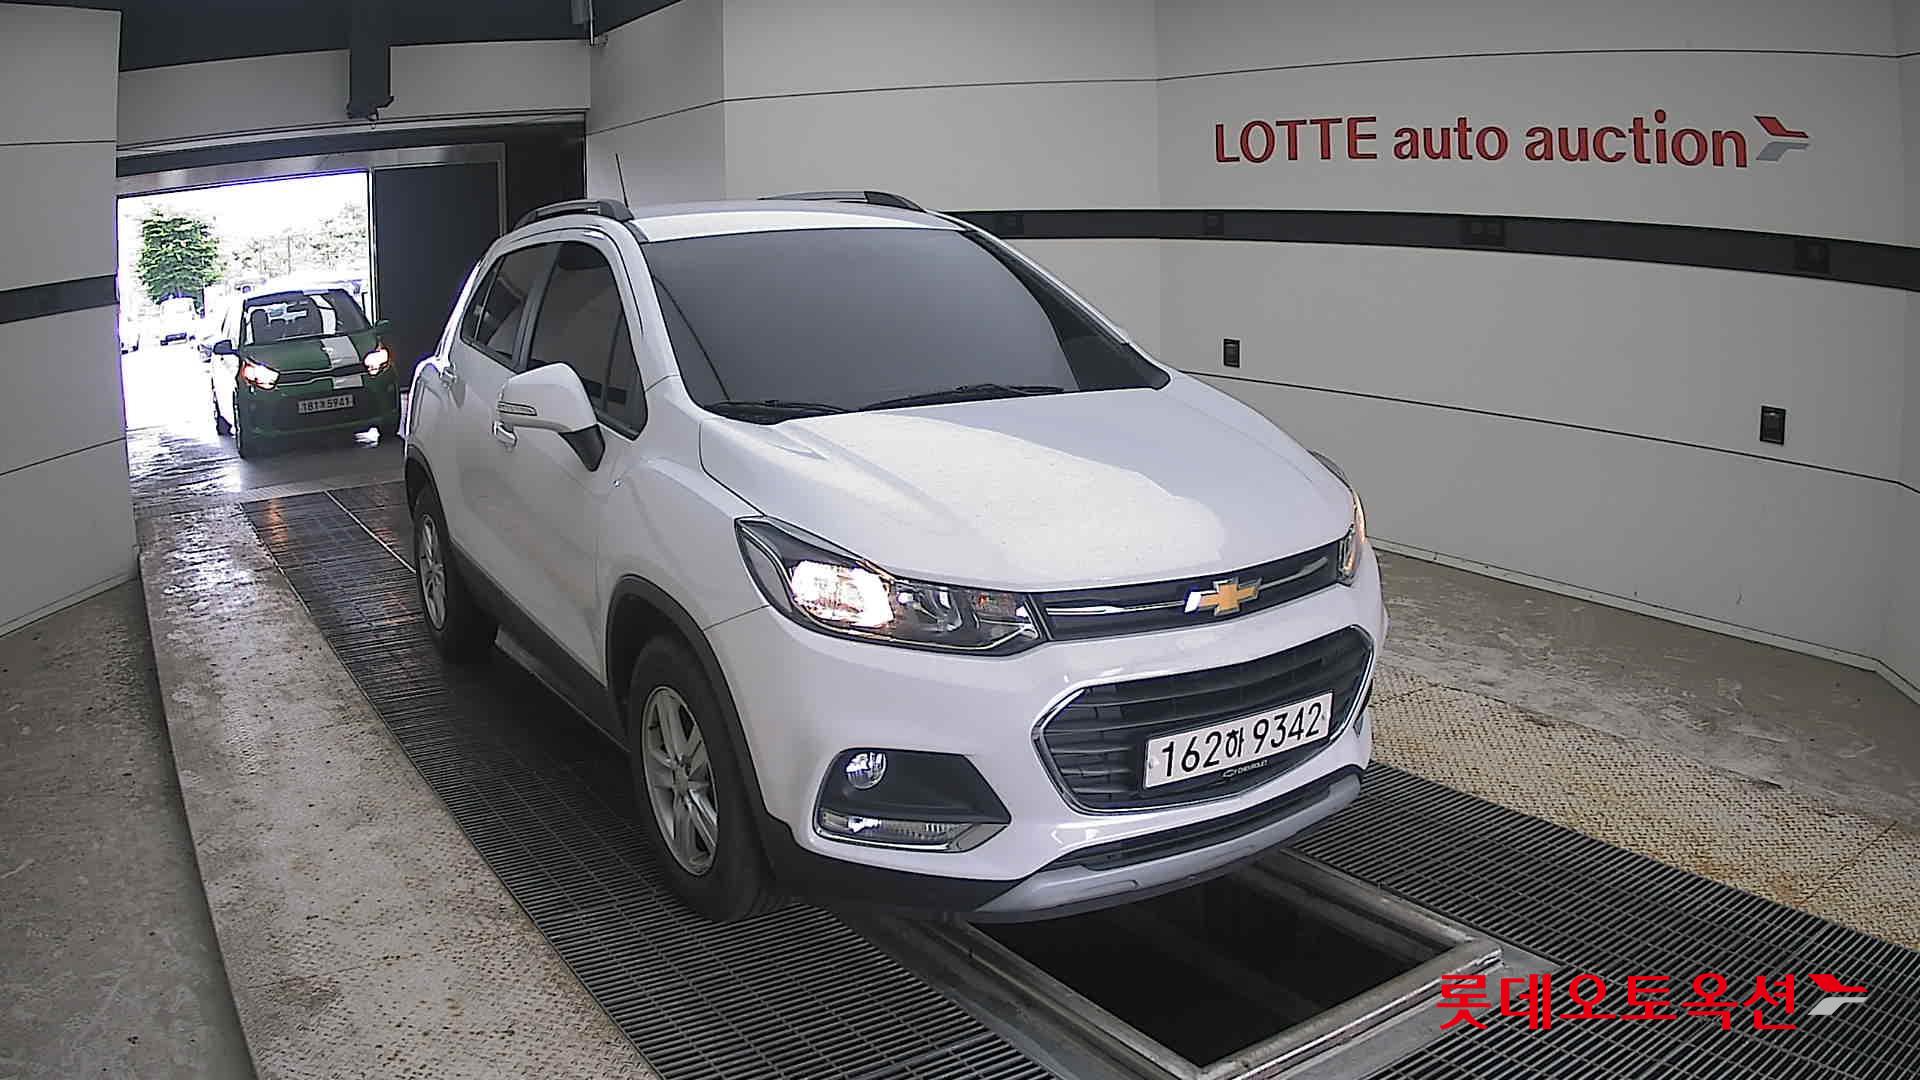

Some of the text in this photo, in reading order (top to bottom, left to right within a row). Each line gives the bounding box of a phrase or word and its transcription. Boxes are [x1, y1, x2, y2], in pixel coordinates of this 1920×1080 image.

[1215, 109, 1748, 168] LOTTE auto auction
[1162, 702, 1322, 777] 162하 9342
